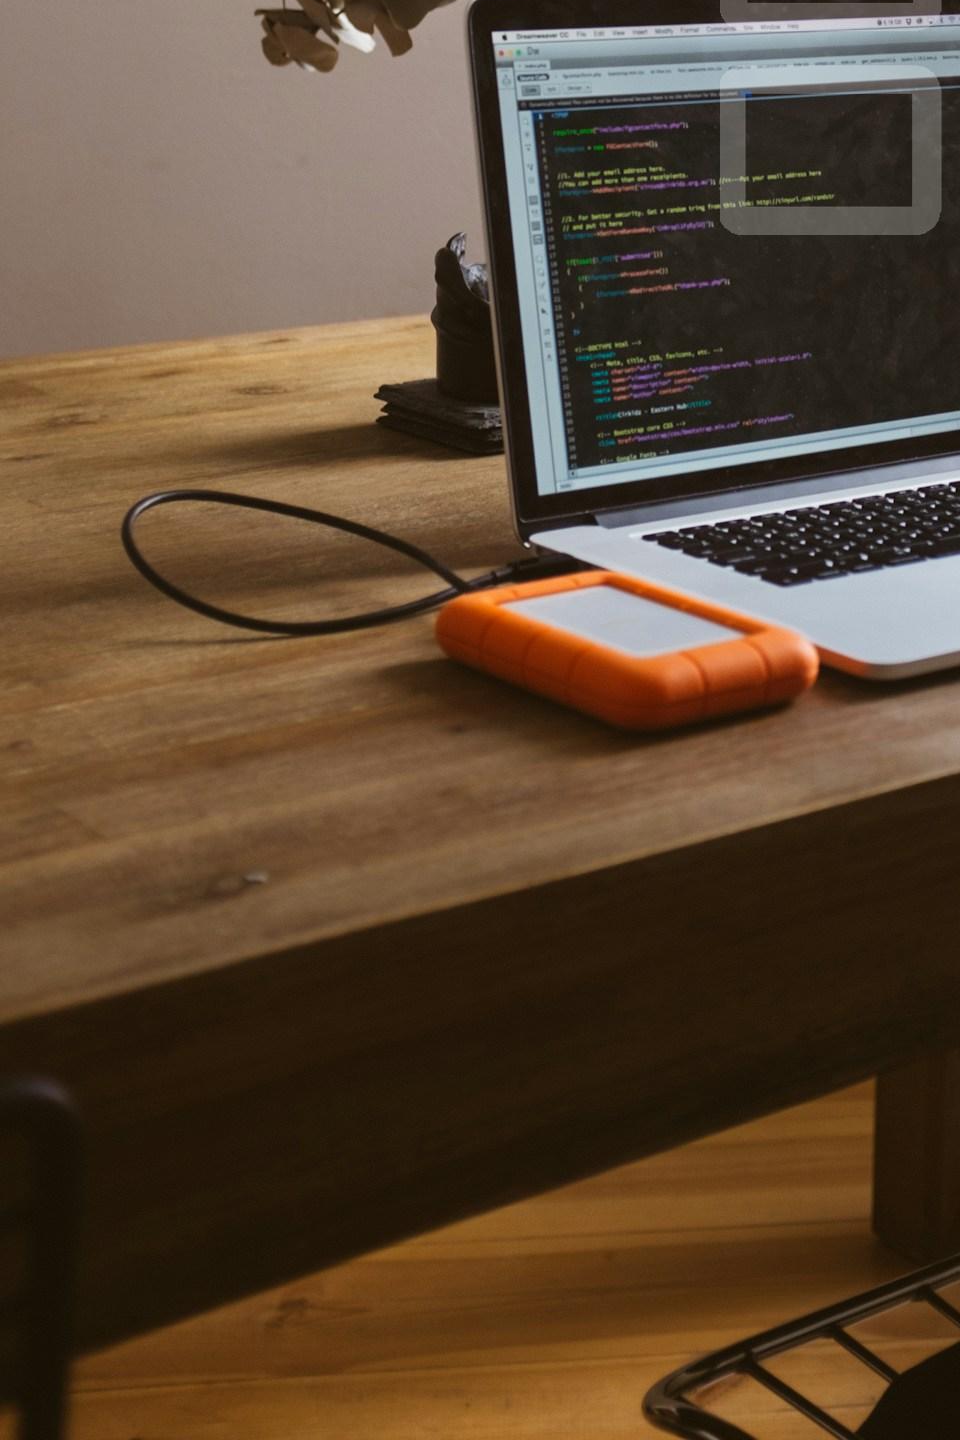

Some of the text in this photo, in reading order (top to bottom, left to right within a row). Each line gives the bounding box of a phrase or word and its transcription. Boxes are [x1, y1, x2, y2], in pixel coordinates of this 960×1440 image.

[587, 170, 601, 178] your
[604, 168, 620, 176] email
[623, 167, 647, 175] address
[591, 212, 612, 220] better
[615, 210, 645, 219] security.
[667, 206, 687, 214] random
[689, 204, 705, 212] tring
[723, 201, 736, 209] this
[586, 223, 598, 231] put
[615, 340, 628, 348] html
[649, 354, 663, 362] CSS,
[651, 404, 674, 414] Eastern
[614, 427, 644, 437] Bootstrap
[647, 424, 661, 432] core
[663, 422, 674, 430] CSS
[616, 453, 637, 462] Google
[640, 451, 657, 459] Fonts
